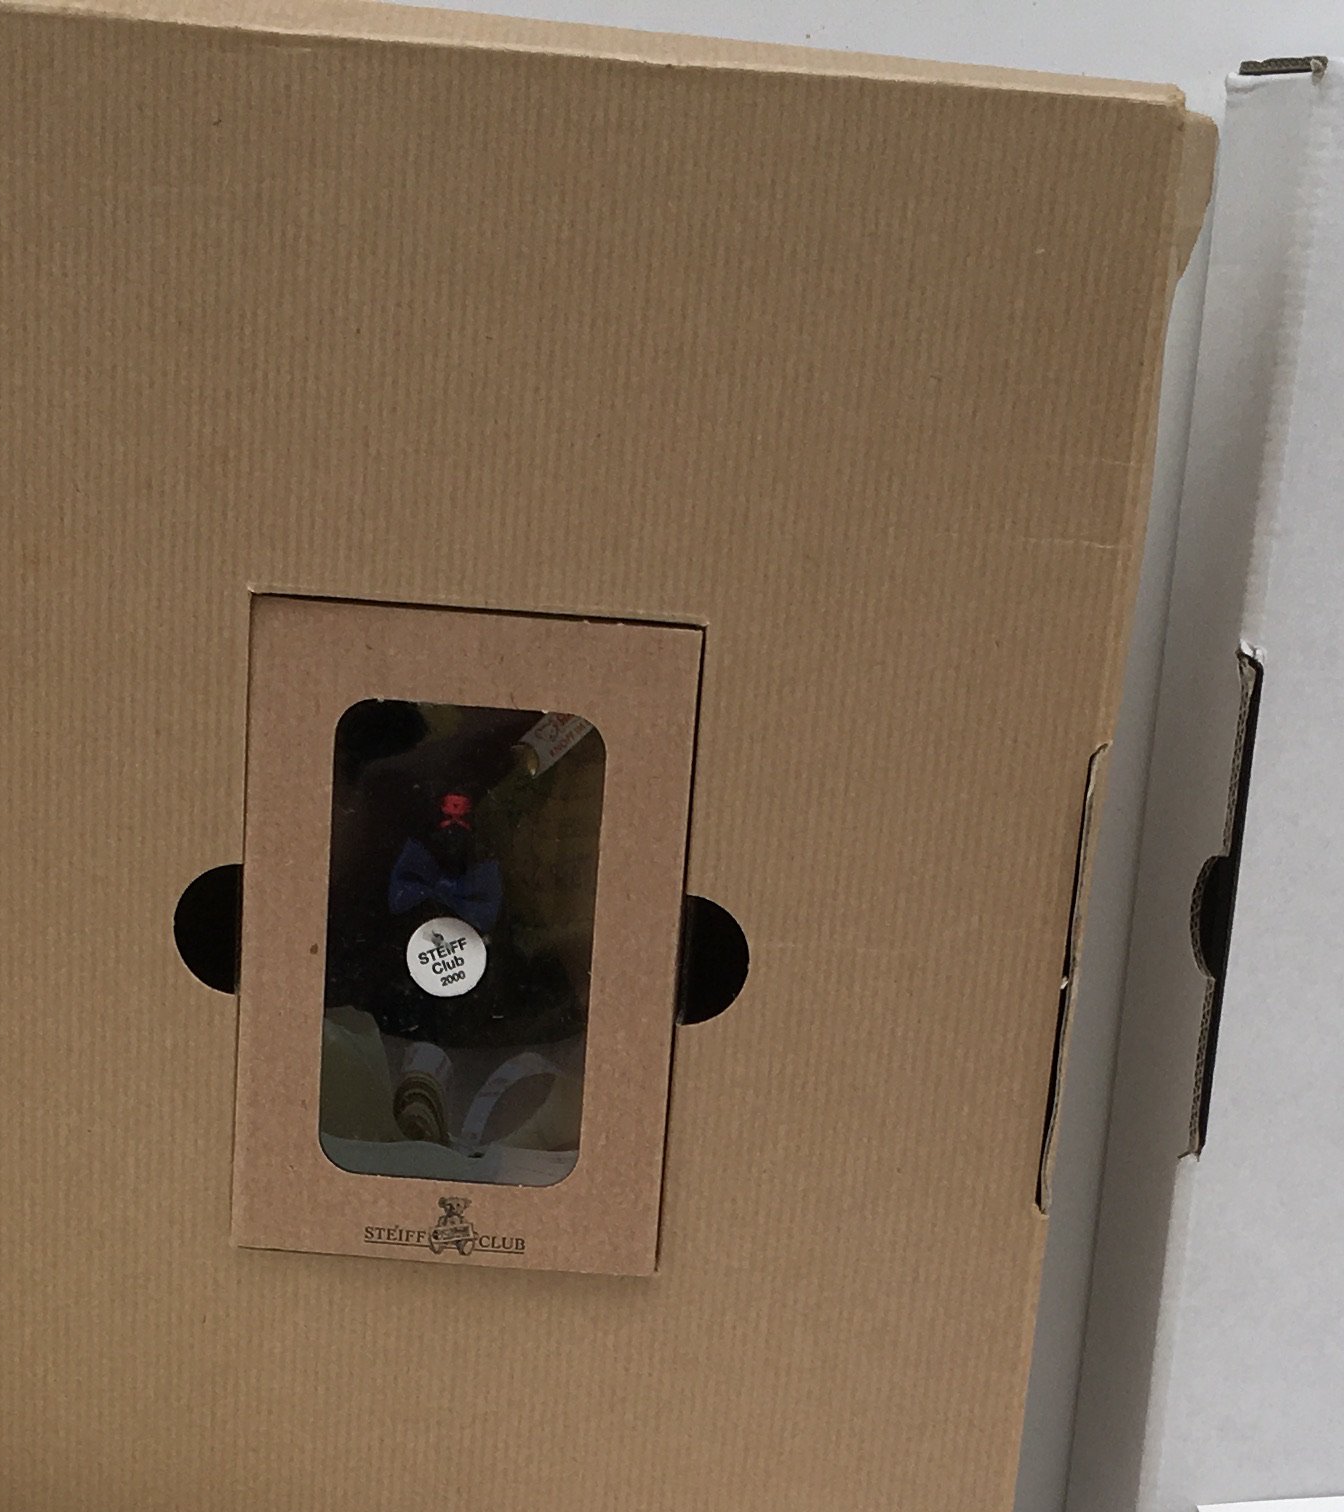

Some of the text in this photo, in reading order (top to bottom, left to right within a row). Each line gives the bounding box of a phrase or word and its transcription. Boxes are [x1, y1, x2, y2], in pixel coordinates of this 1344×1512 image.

[418, 937, 467, 965] STEIFF
[432, 955, 465, 974] Club
[440, 970, 466, 986] 2000
[364, 1226, 526, 1250] STEIFF CLUB
